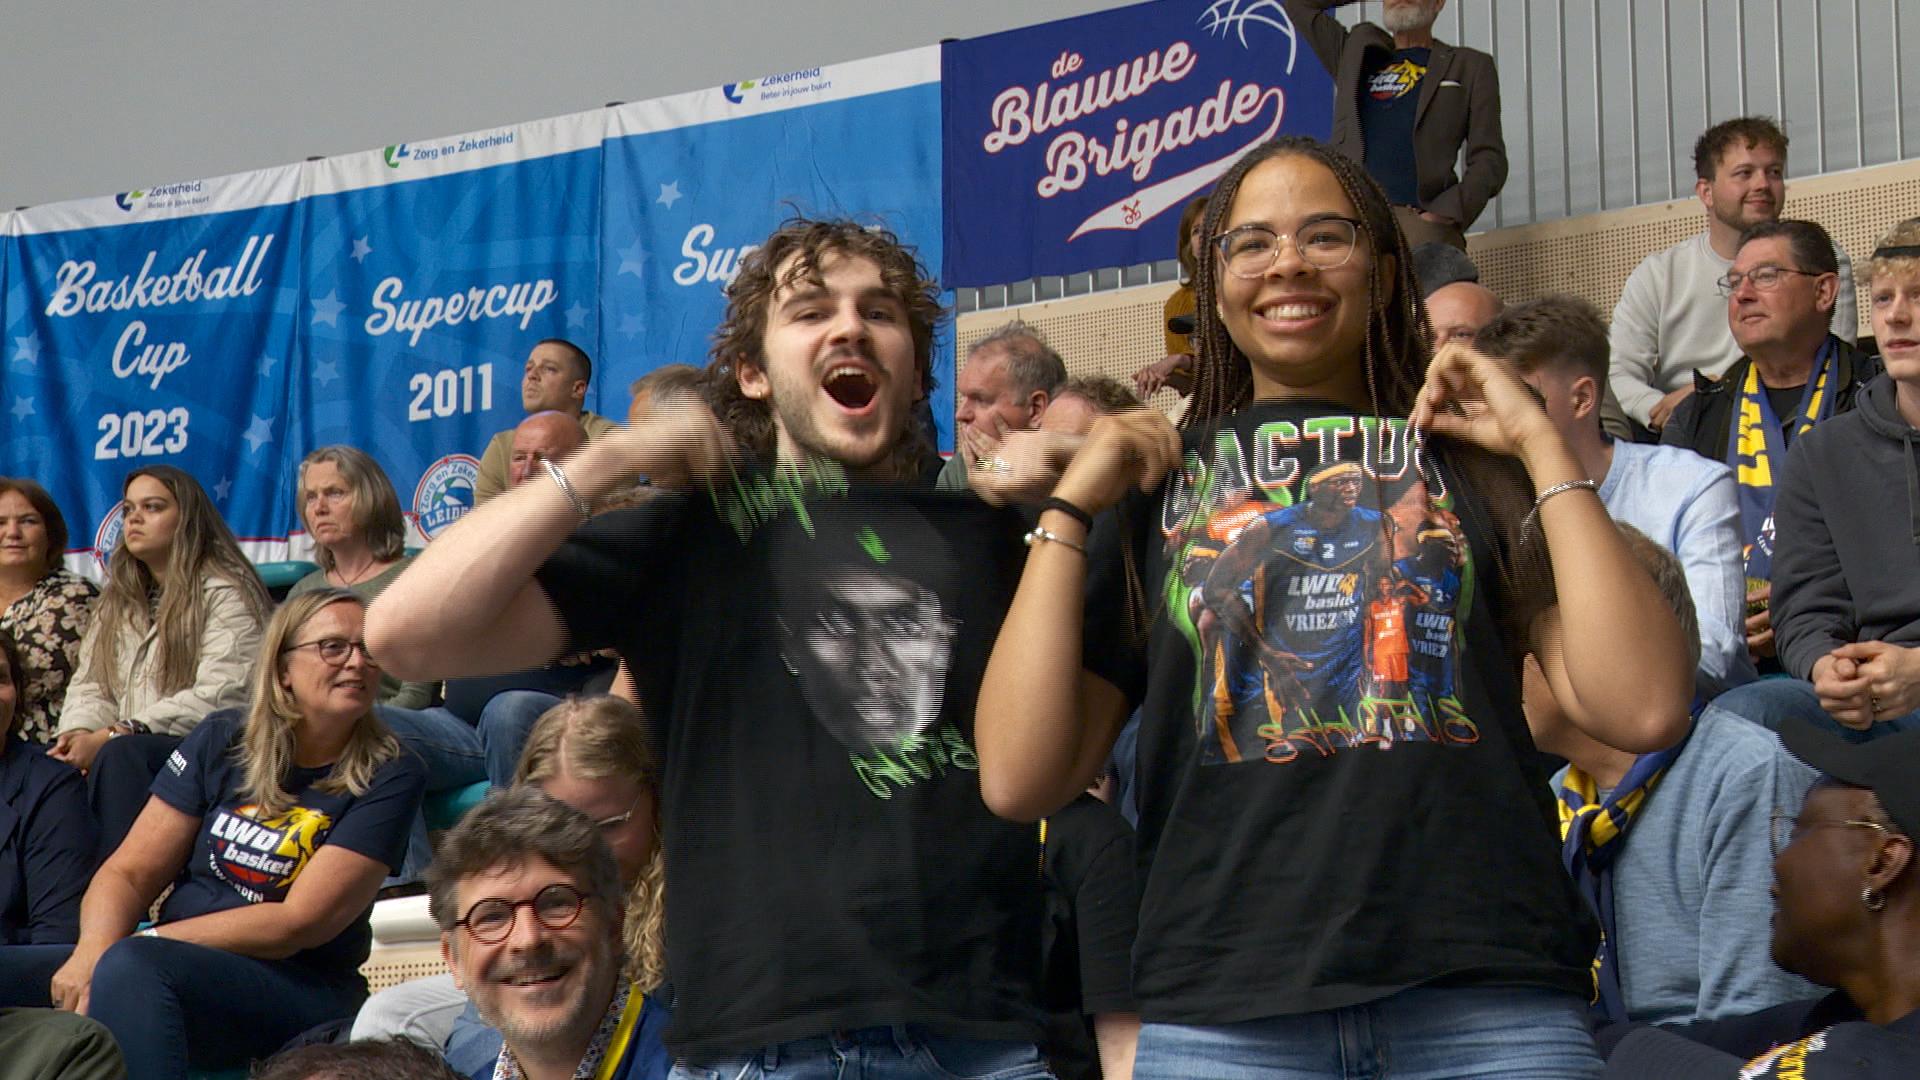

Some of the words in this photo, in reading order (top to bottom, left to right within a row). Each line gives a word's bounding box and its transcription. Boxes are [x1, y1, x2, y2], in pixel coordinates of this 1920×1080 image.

[760, 67, 821, 87] Zekerheid
[1052, 51, 1083, 80] de
[811, 81, 832, 93] buurt
[984, 40, 1198, 153] Blauwe
[413, 148, 439, 160] Zorg
[441, 145, 455, 156] en
[458, 132, 514, 153] Zekerheid
[1037, 79, 1265, 199] Brigade
[148, 181, 202, 198] Zekerheid
[45, 233, 274, 318] Basketball
[364, 276, 559, 347] Supercup
[112, 320, 191, 390] Cup
[408, 363, 493, 422] 2011
[94, 407, 189, 460] 2023
[420, 482, 437, 509] Zorg
[436, 470, 449, 481] en
[451, 463, 478, 482] Zeker
[425, 506, 469, 527] LEID
[1321, 543, 1335, 559] 2
[210, 812, 280, 852] LWD
[223, 842, 294, 876] basket
